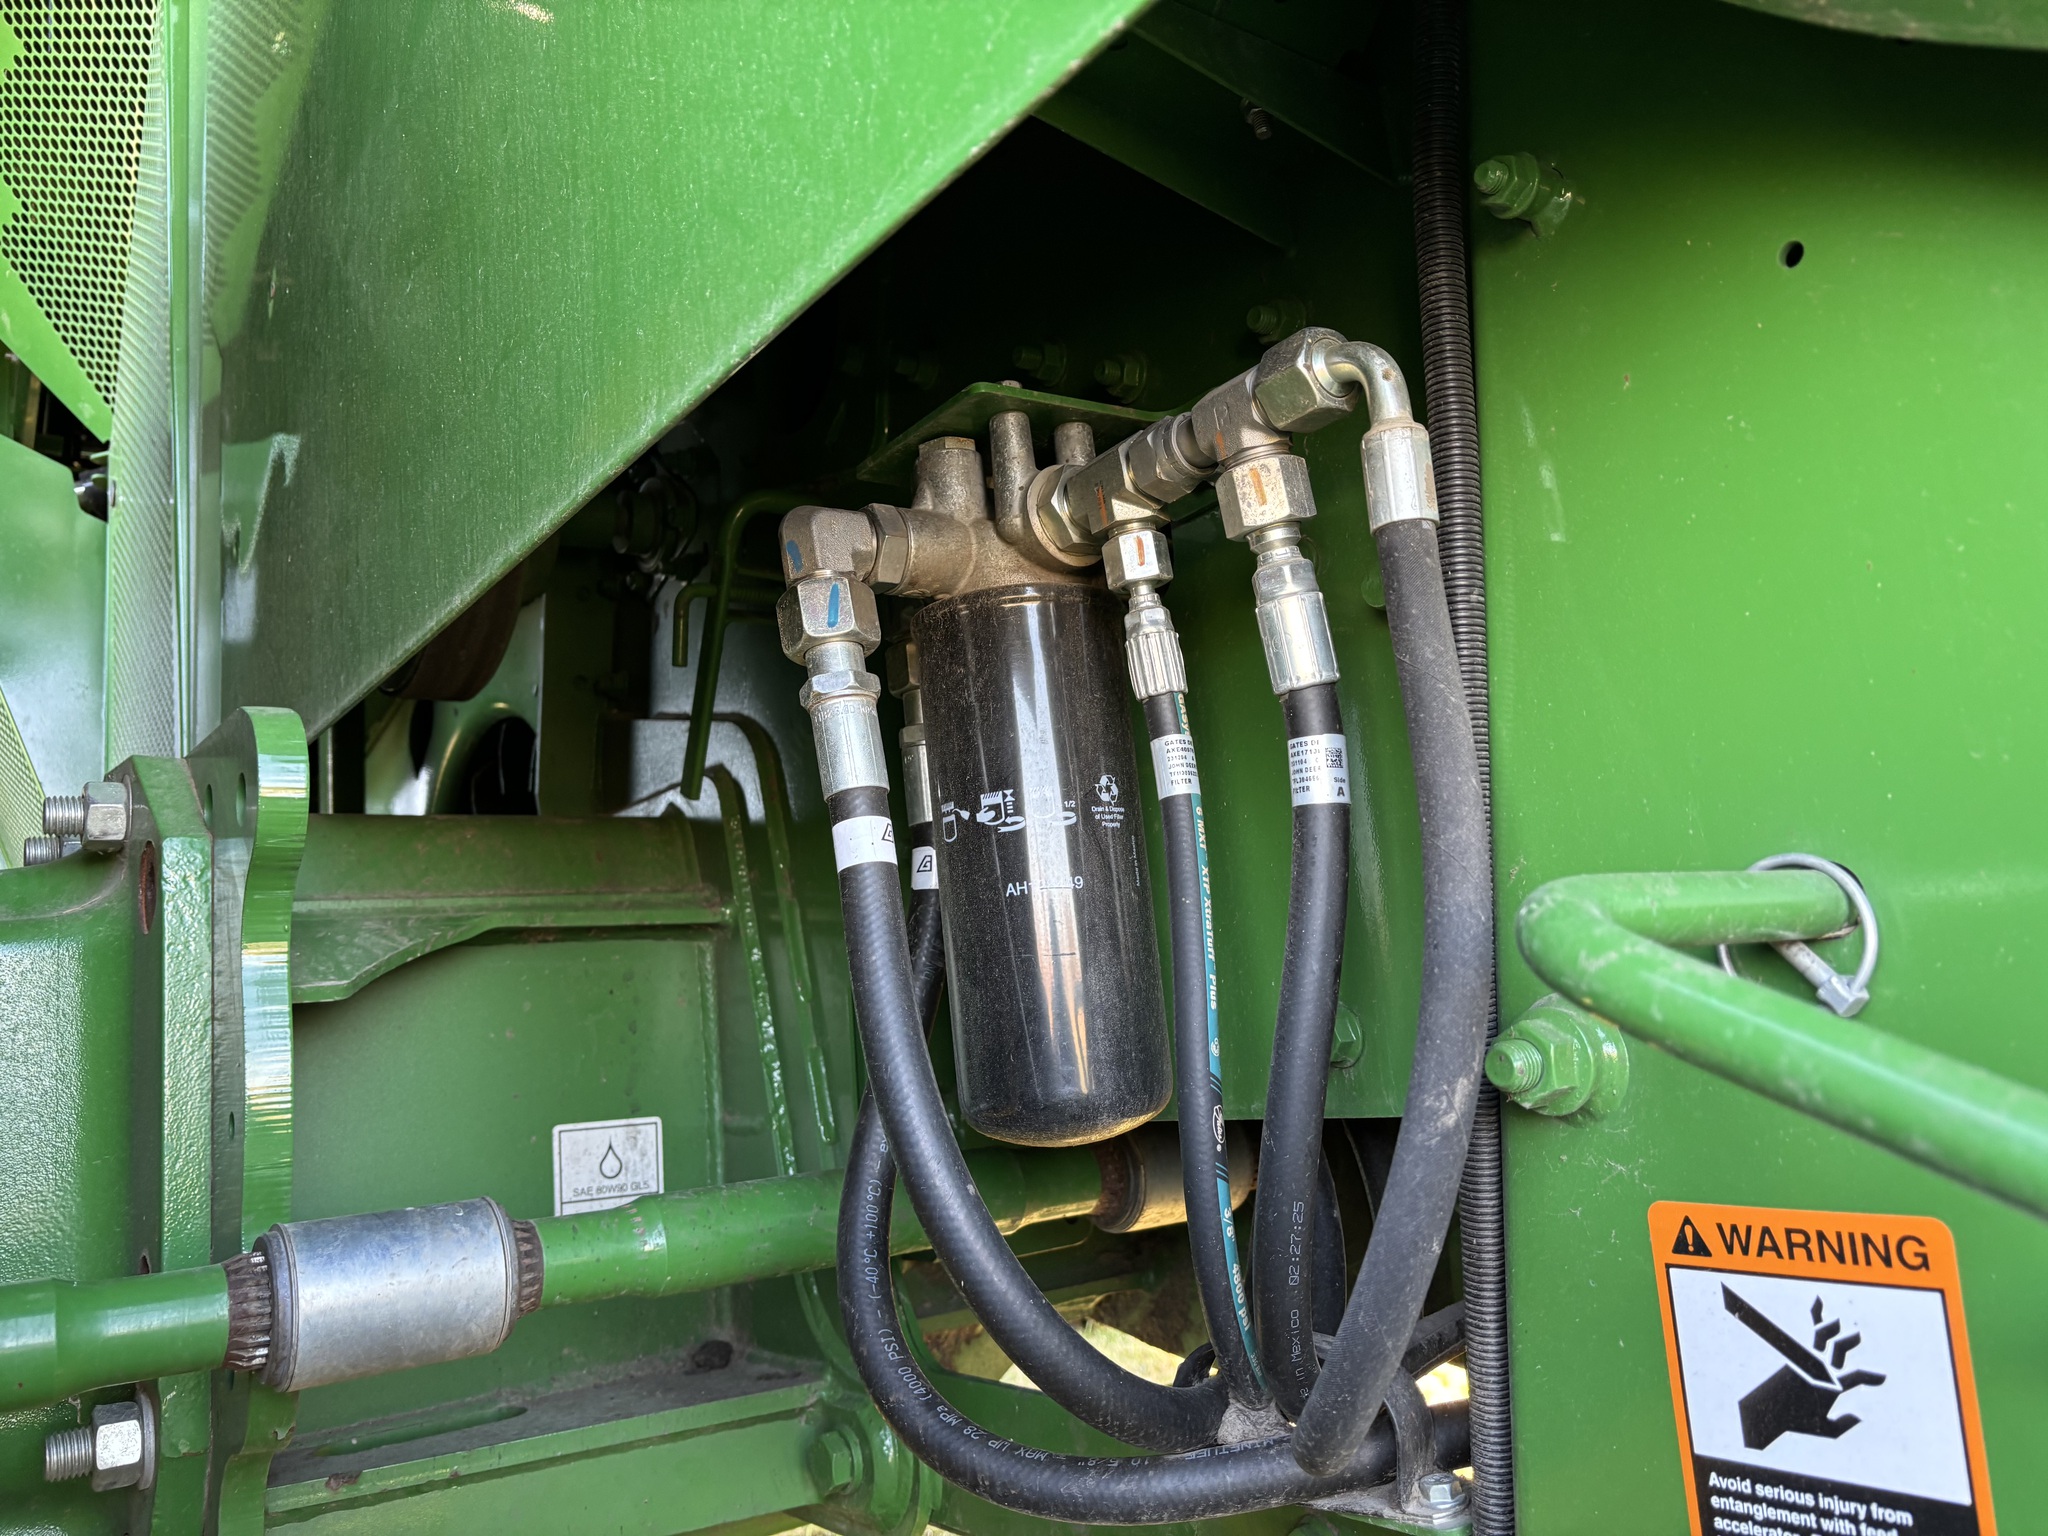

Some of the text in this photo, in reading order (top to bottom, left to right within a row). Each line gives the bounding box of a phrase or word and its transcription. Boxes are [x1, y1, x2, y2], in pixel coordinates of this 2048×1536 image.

[1171, 778, 1192, 786] FILTER
[1337, 786, 1346, 797] A
[1064, 800, 1076, 808] 1/2
[1201, 865, 1211, 894] XTP
[1204, 896, 1216, 962] XtraTuff
[1209, 974, 1218, 1010] Plus
[573, 1186, 594, 1197] SAE
[1289, 1201, 1305, 1286] 02:27:25
[1715, 1221, 1930, 1272] WARNING
[1232, 1263, 1245, 1304] 4800
[1238, 1308, 1250, 1332] psi
[1291, 1310, 1300, 1362] Mexico
[878, 1328, 905, 1361] PSI)
[898, 1366, 932, 1401] (4000
[937, 1405, 963, 1426] MPa
[963, 1425, 988, 1440] 28
[1015, 1446, 1049, 1462] MAX
[1709, 1471, 1914, 1527] Avoid serious injury from
[1710, 1495, 1818, 1529] entanglement
[1820, 1517, 1857, 1536] with
